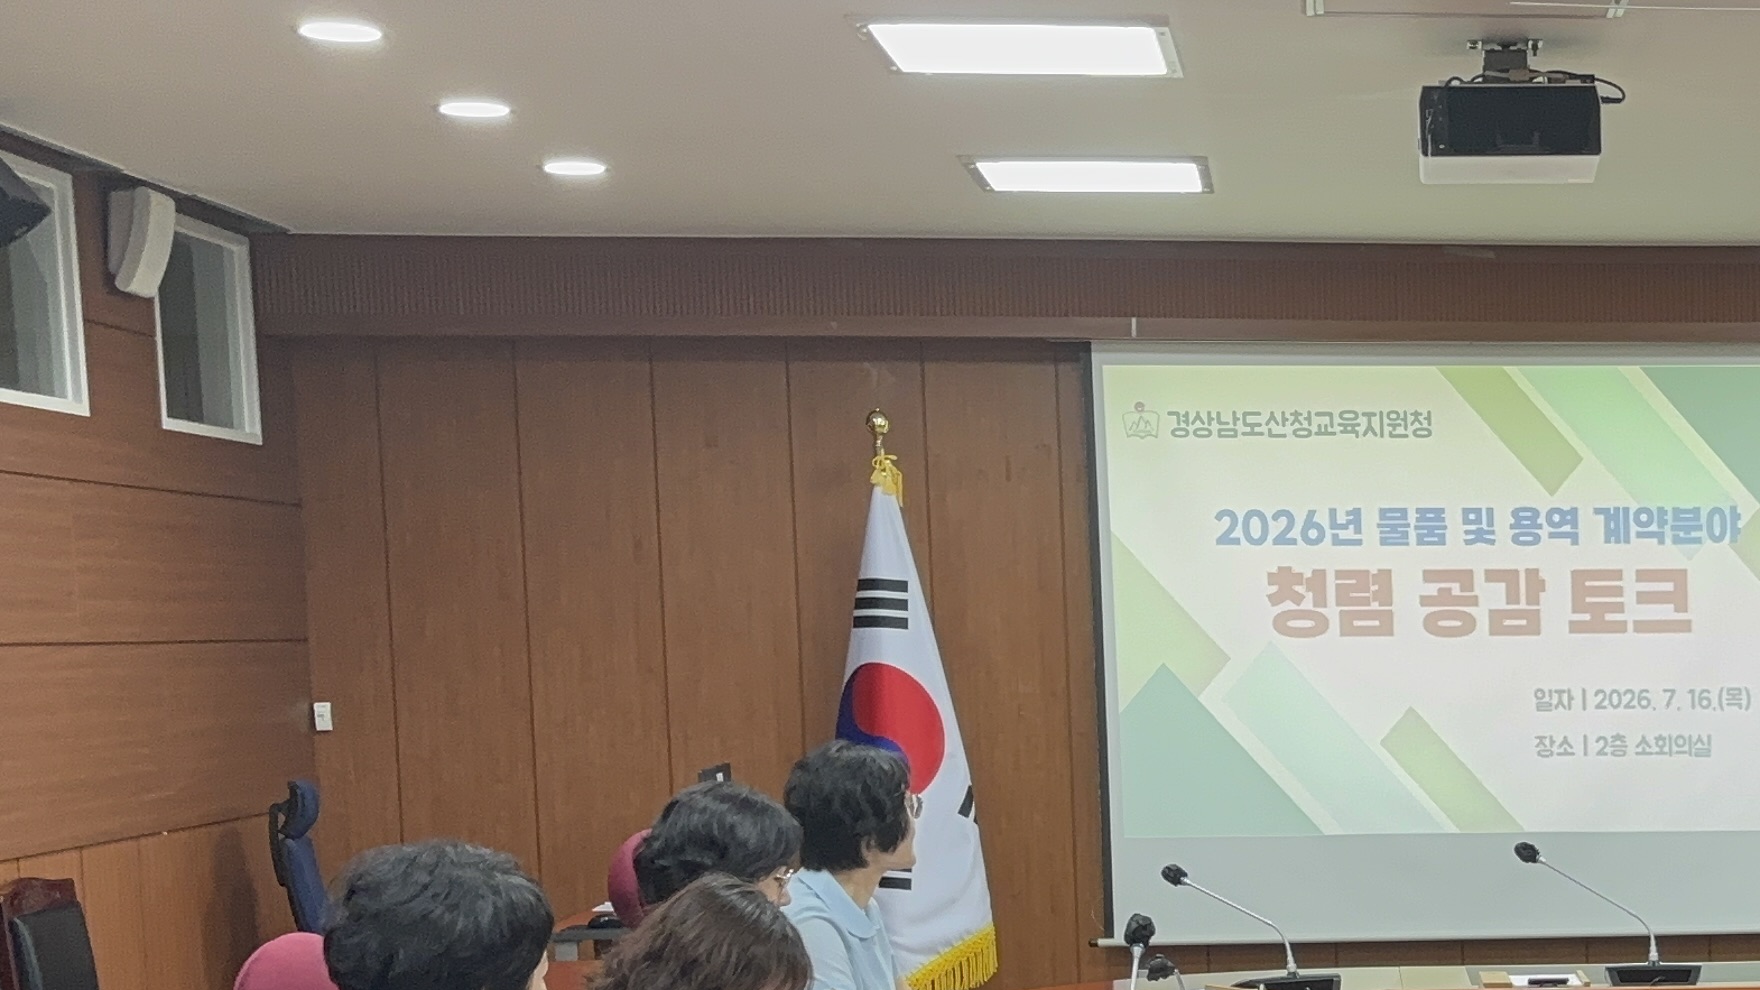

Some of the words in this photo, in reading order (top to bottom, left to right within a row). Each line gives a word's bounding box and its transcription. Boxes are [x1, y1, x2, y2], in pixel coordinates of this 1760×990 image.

[1166, 408, 1434, 440] 경상남도산청교육지원청
[1213, 506, 1364, 547] 2026년
[1376, 506, 1449, 547] 물품
[1461, 506, 1497, 547] 및
[1509, 505, 1580, 547] 용역
[1592, 505, 1742, 546] 계약분야
[1265, 565, 1395, 639] 청렴
[1418, 567, 1547, 639] 공감
[1567, 567, 1693, 635] 토크
[1533, 687, 1575, 713] 일자
[1593, 688, 1657, 712] 2026.
[1661, 688, 1681, 712] 7.
[1686, 685, 1752, 712] 16.(목)
[1533, 733, 1576, 758] 장소
[1594, 732, 1629, 758] 2층
[1634, 733, 1713, 758] 소회의실
